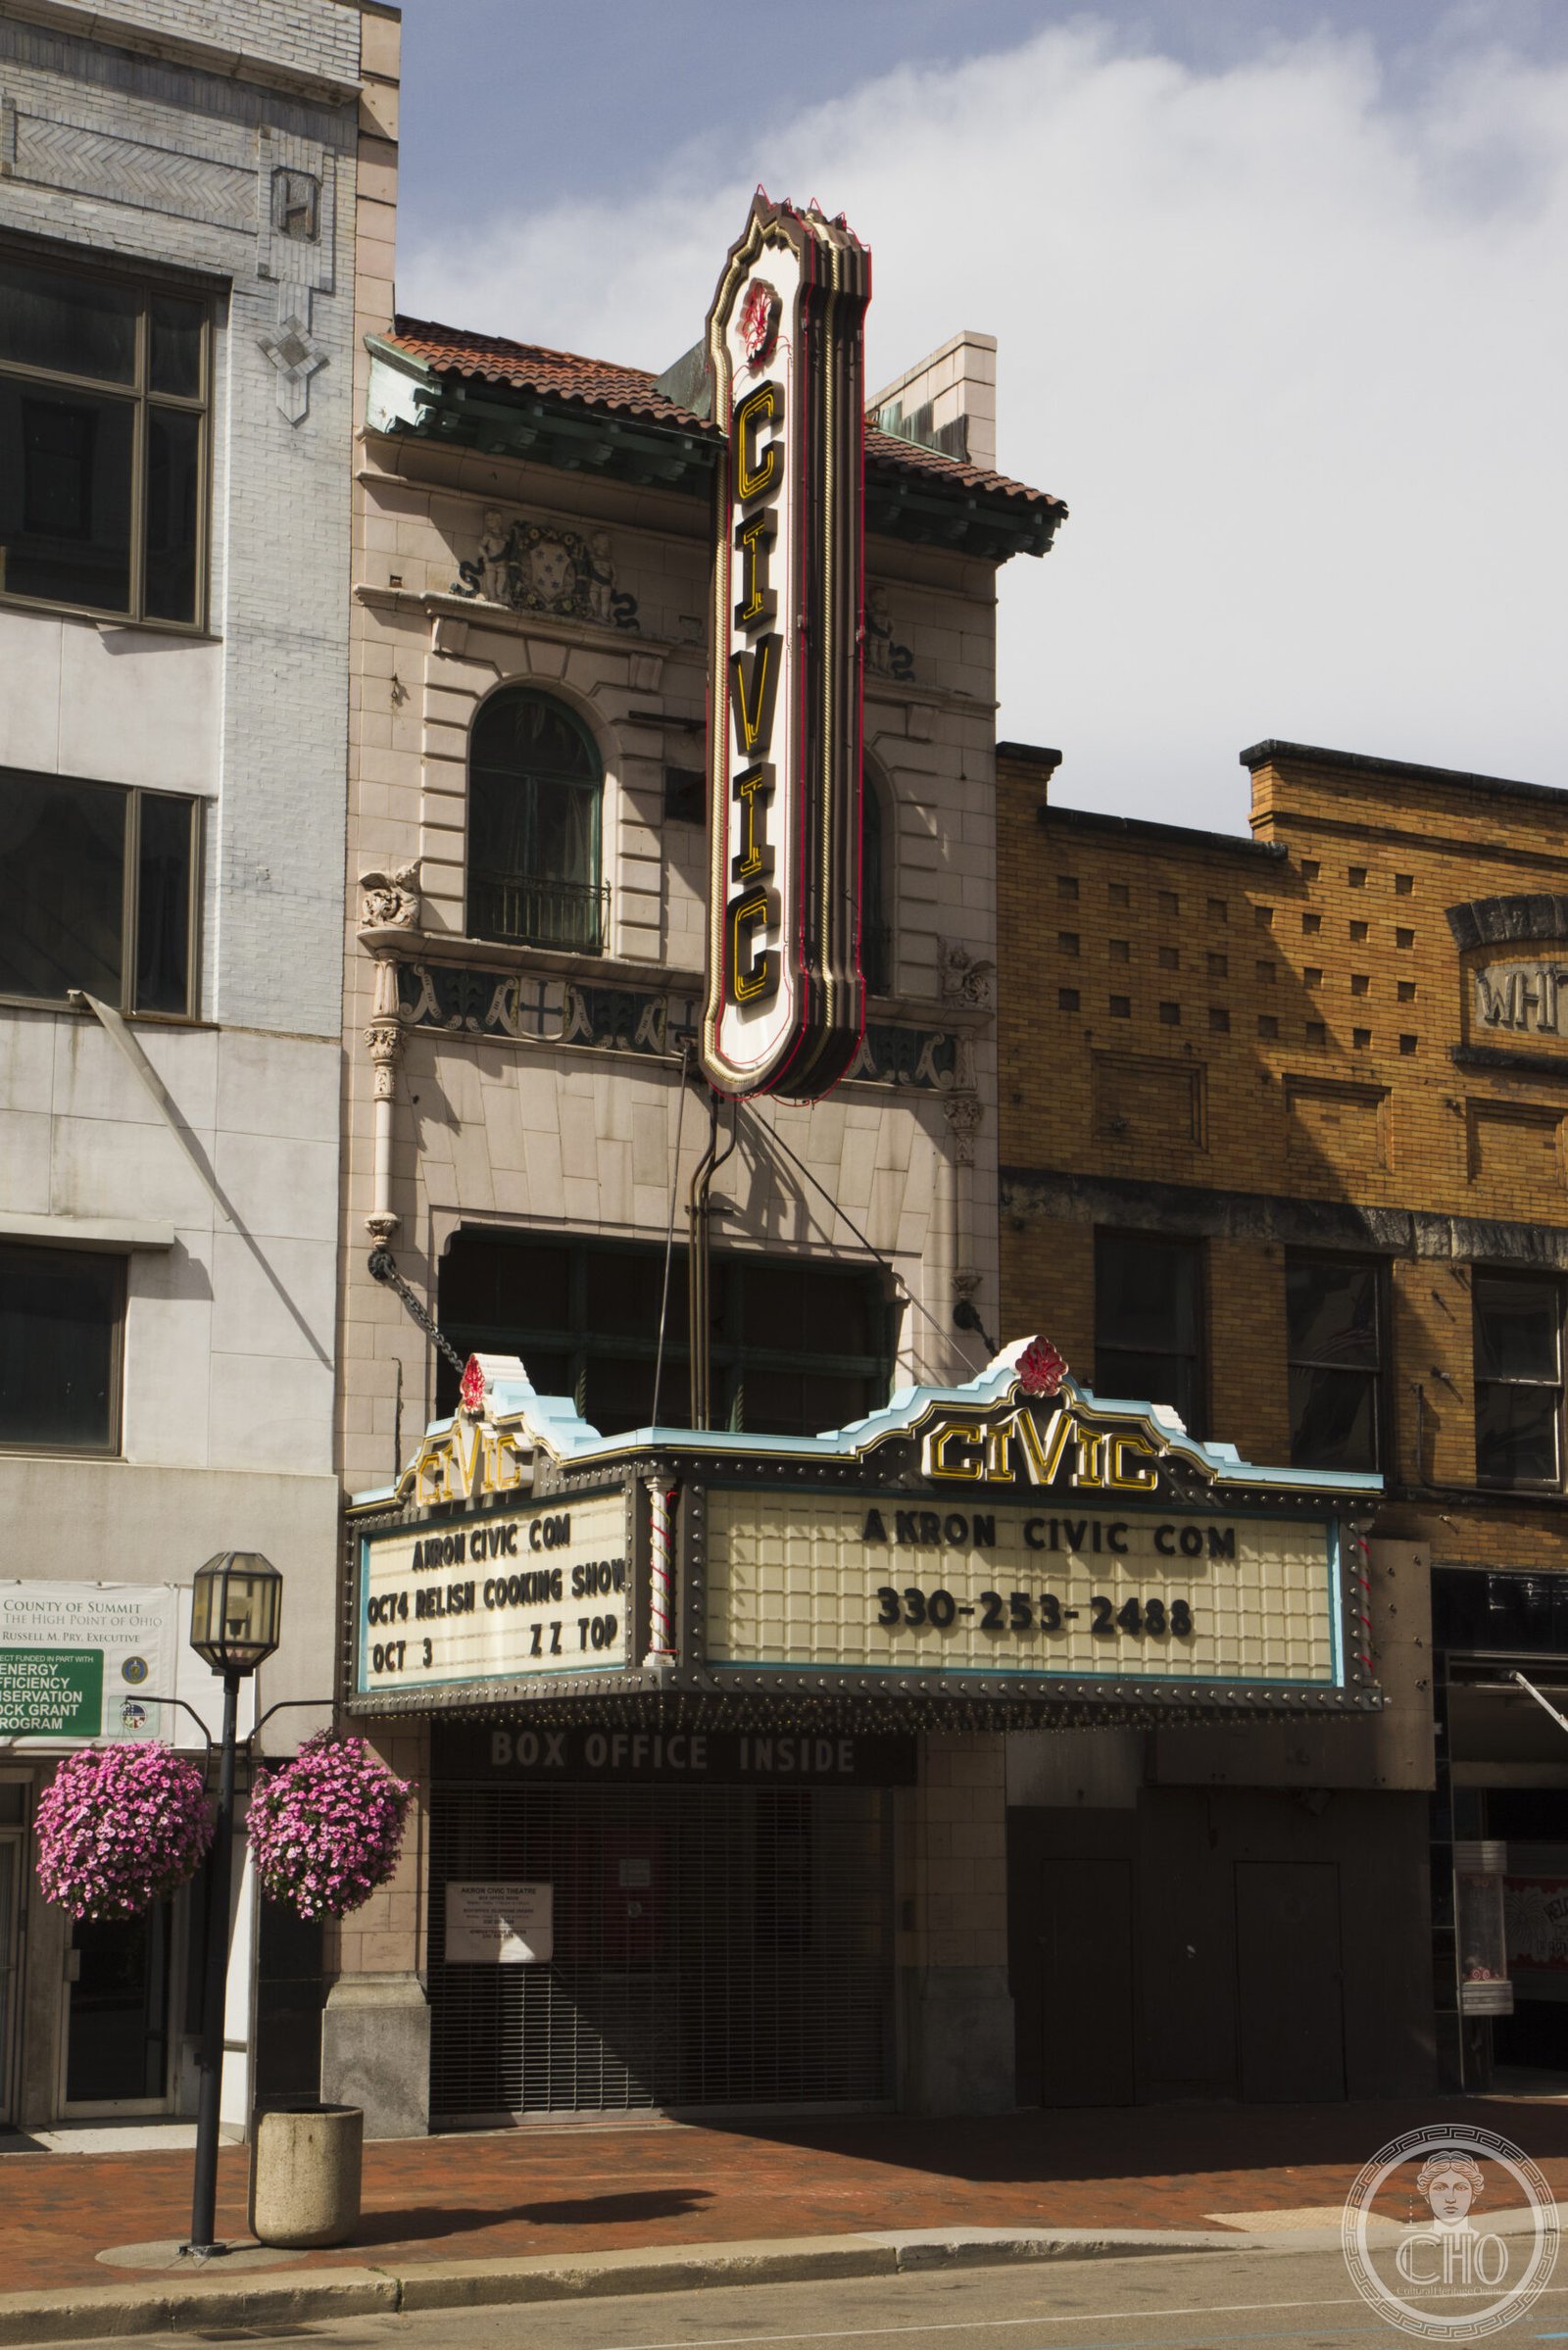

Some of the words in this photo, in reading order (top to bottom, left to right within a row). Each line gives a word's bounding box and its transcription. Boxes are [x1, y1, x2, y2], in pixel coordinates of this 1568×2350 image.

[727, 378, 784, 1008] CIVIC
[417, 1421, 535, 1507] CIVIC
[922, 1407, 1159, 1492] CIVIC
[412, 1532, 466, 1571] AKRON
[469, 1523, 517, 1563] CIVIC
[528, 1513, 571, 1551] COM
[862, 1508, 997, 1547] AKRON
[1023, 1516, 1130, 1554] CIVIC
[1153, 1525, 1236, 1559] COM
[4, 1599, 62, 1613] COUNTY
[66, 1602, 84, 1613] OF
[88, 1601, 142, 1614] SUMMIT
[416, 1580, 475, 1620] RELISH
[483, 1567, 563, 1609] COOKING
[571, 1556, 625, 1597] SHOW
[877, 1587, 1194, 1637] 330-253-2488
[3, 1631, 45, 1641] RUSSELL
[87, 1633, 141, 1642] EXECUTIVE
[4, 1613, 26, 1624] THE
[32, 1613, 65, 1625] HIGH
[71, 1615, 107, 1626] POINT
[111, 1616, 127, 1627] OF
[129, 1616, 162, 1627] OHIO
[372, 1640, 407, 1674] OCT
[422, 1637, 433, 1667] 3
[577, 1614, 617, 1650] TOP
[0, 1663, 58, 1676] ENERGY
[0, 1690, 82, 1703] SERVATION
[28, 1703, 79, 1716] GRANT
[492, 1731, 566, 1767] BOX
[584, 1733, 709, 1770] OFFICE
[739, 1737, 855, 1773] INSIDE
